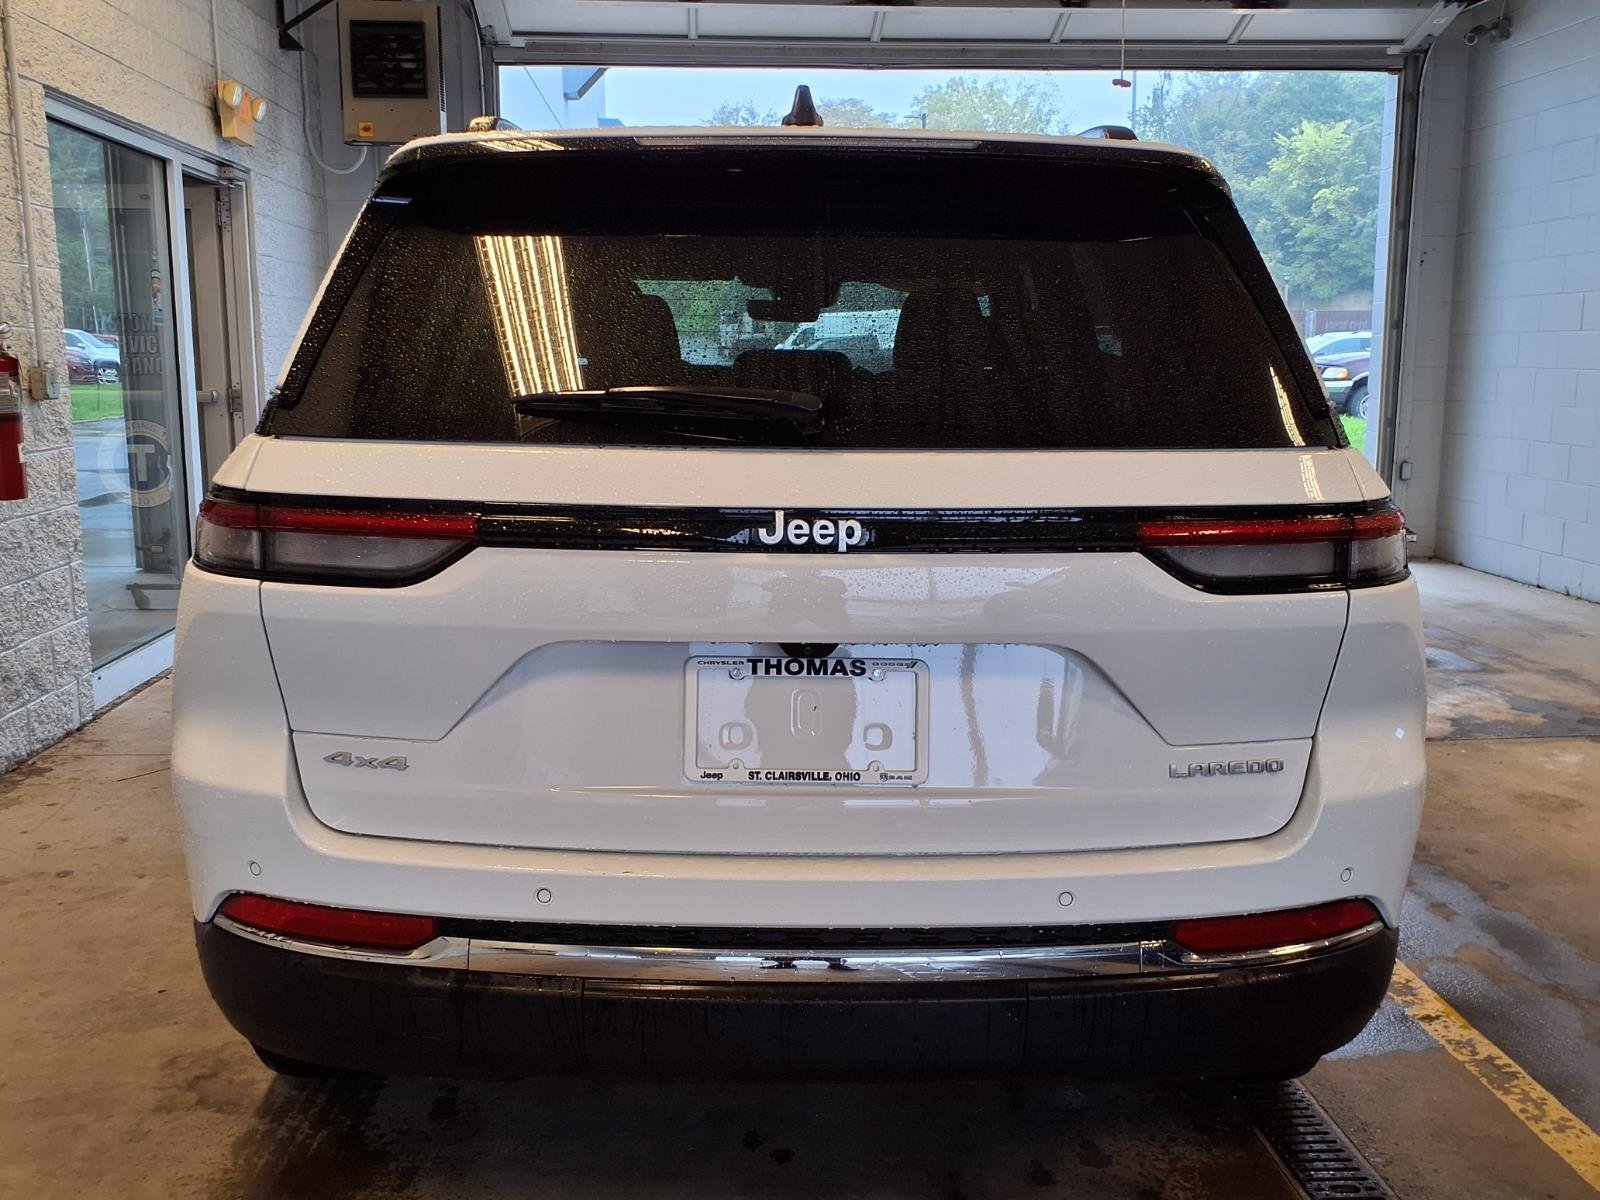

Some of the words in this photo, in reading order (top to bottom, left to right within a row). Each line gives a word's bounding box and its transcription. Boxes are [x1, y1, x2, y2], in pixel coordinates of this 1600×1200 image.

[758, 510, 862, 552] Jeep
[746, 658, 867, 677] THOMAS
[322, 751, 410, 772] 4x4
[1168, 759, 1285, 779] LAREDO
[700, 771, 724, 781] Jeep
[748, 771, 763, 781] ST.
[765, 771, 832, 782] CLAIRSVILLE,
[834, 771, 862, 782] OHIO
